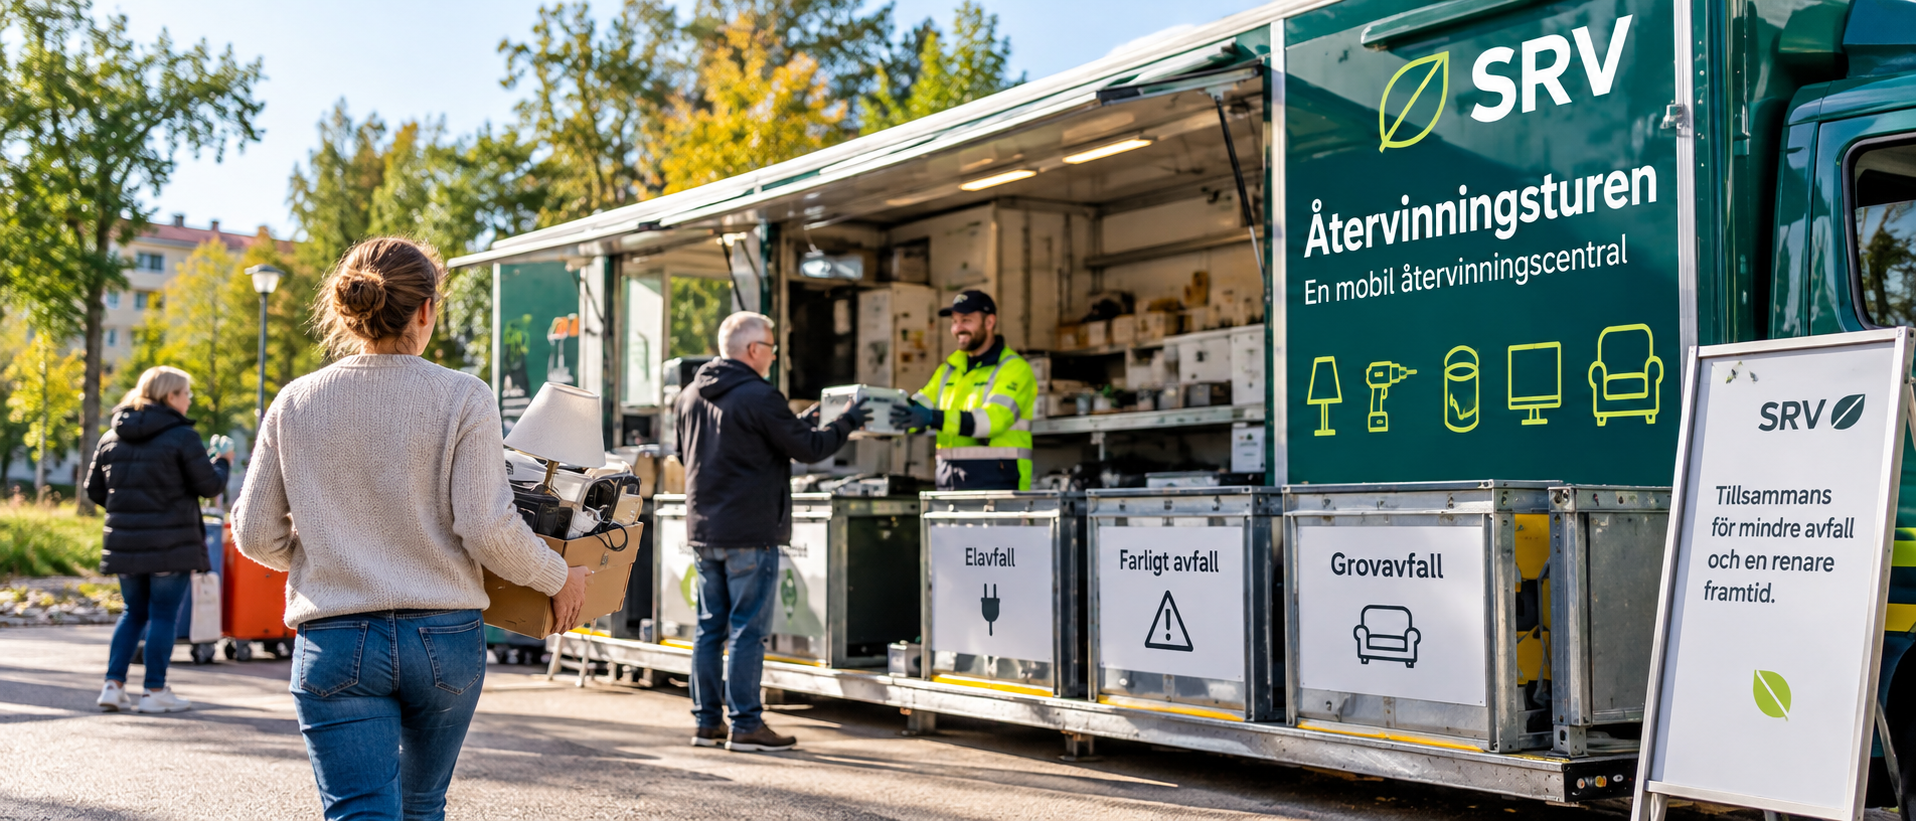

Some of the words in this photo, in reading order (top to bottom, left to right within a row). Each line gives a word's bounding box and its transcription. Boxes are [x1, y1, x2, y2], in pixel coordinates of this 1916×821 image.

[1470, 13, 1634, 123] SRV
[1303, 165, 1657, 258] Återvinningsturen
[1305, 279, 1329, 305] En
[1336, 267, 1395, 302] mobil
[1401, 233, 1628, 292] återvinningscentral
[1758, 399, 1827, 431] SRV
[1715, 485, 1832, 505] Tillsammans
[1711, 517, 1737, 537] för
[1738, 517, 1801, 538] mindre
[1804, 517, 1855, 539] avfall
[965, 546, 1016, 568] Elavfall
[1119, 548, 1170, 576] Farligt
[1173, 549, 1220, 573] avfall
[1330, 551, 1444, 579] Grovavfall
[1707, 548, 1741, 570] och
[1744, 554, 1767, 571] en
[1771, 555, 1835, 573] renare
[1704, 579, 1775, 604] framtid.
